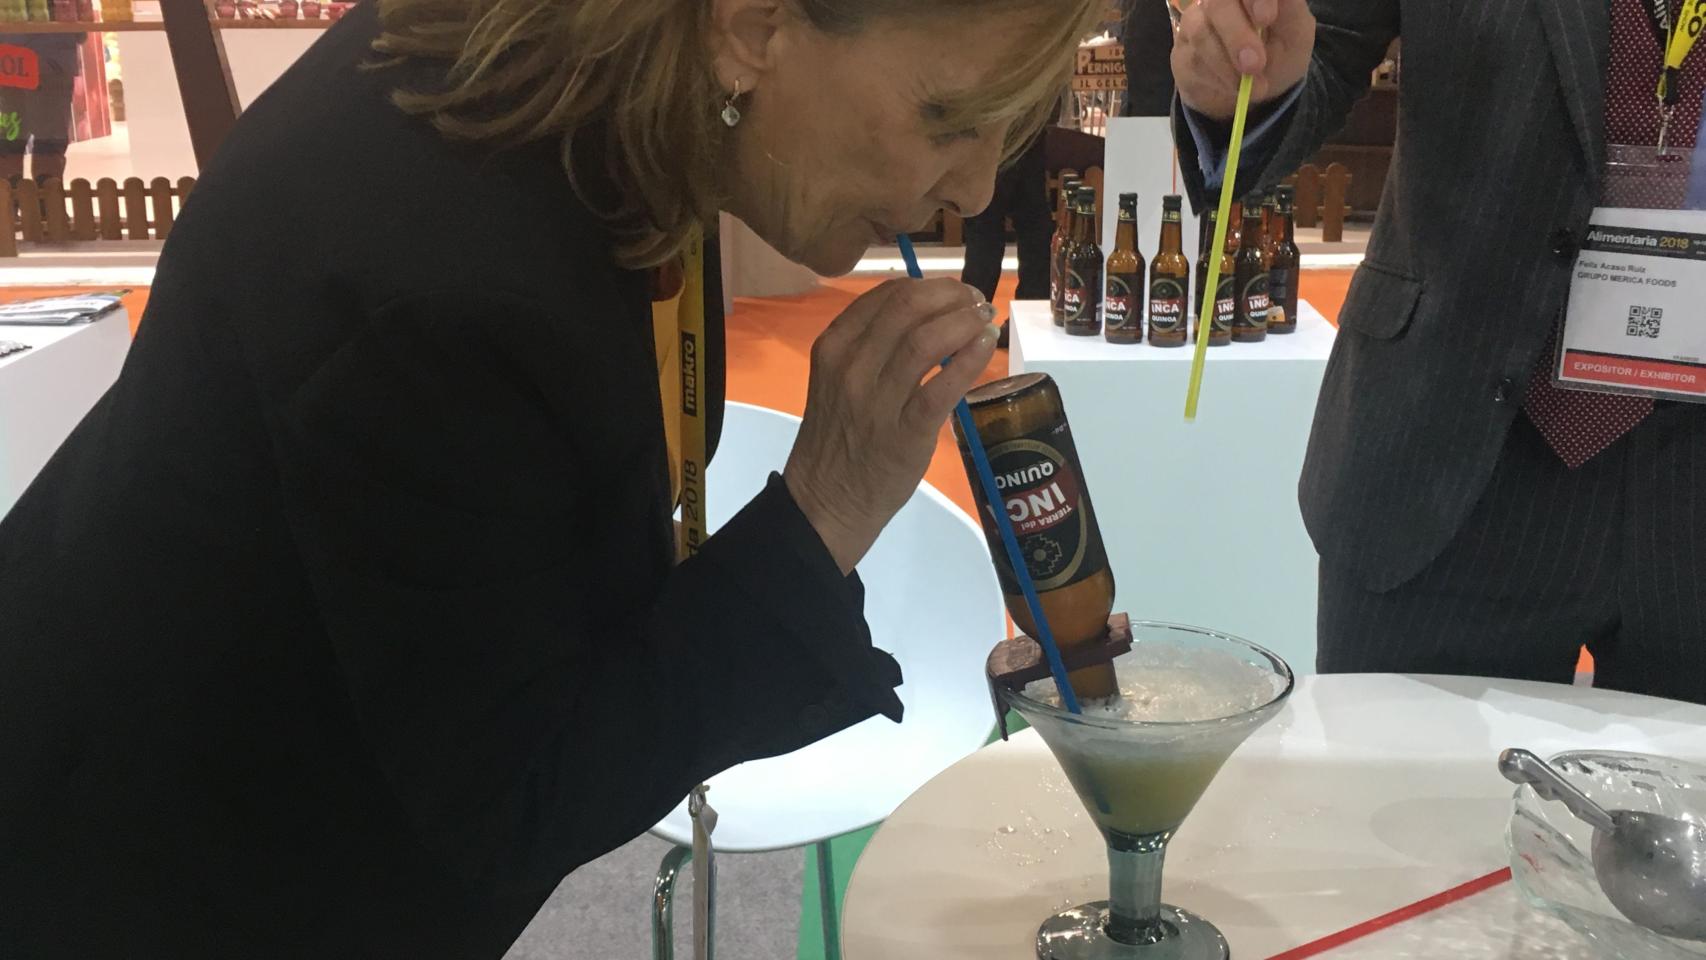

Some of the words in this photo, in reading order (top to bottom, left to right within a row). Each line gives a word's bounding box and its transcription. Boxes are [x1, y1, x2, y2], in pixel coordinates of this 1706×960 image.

[1080, 79, 1091, 88] IL
[1587, 231, 1658, 247] Alimentaria
[1659, 236, 1689, 249] 2018
[1577, 271, 1609, 281] GRUPO
[1645, 278, 1677, 288] FOODS
[1151, 303, 1179, 313] INCA
[684, 340, 695, 410] makro
[1574, 361, 1632, 376] EXPOSITOR
[1640, 369, 1697, 384] EXHIBITOR
[684, 459, 698, 522] 2018
[1039, 504, 1072, 526] TIERRA
